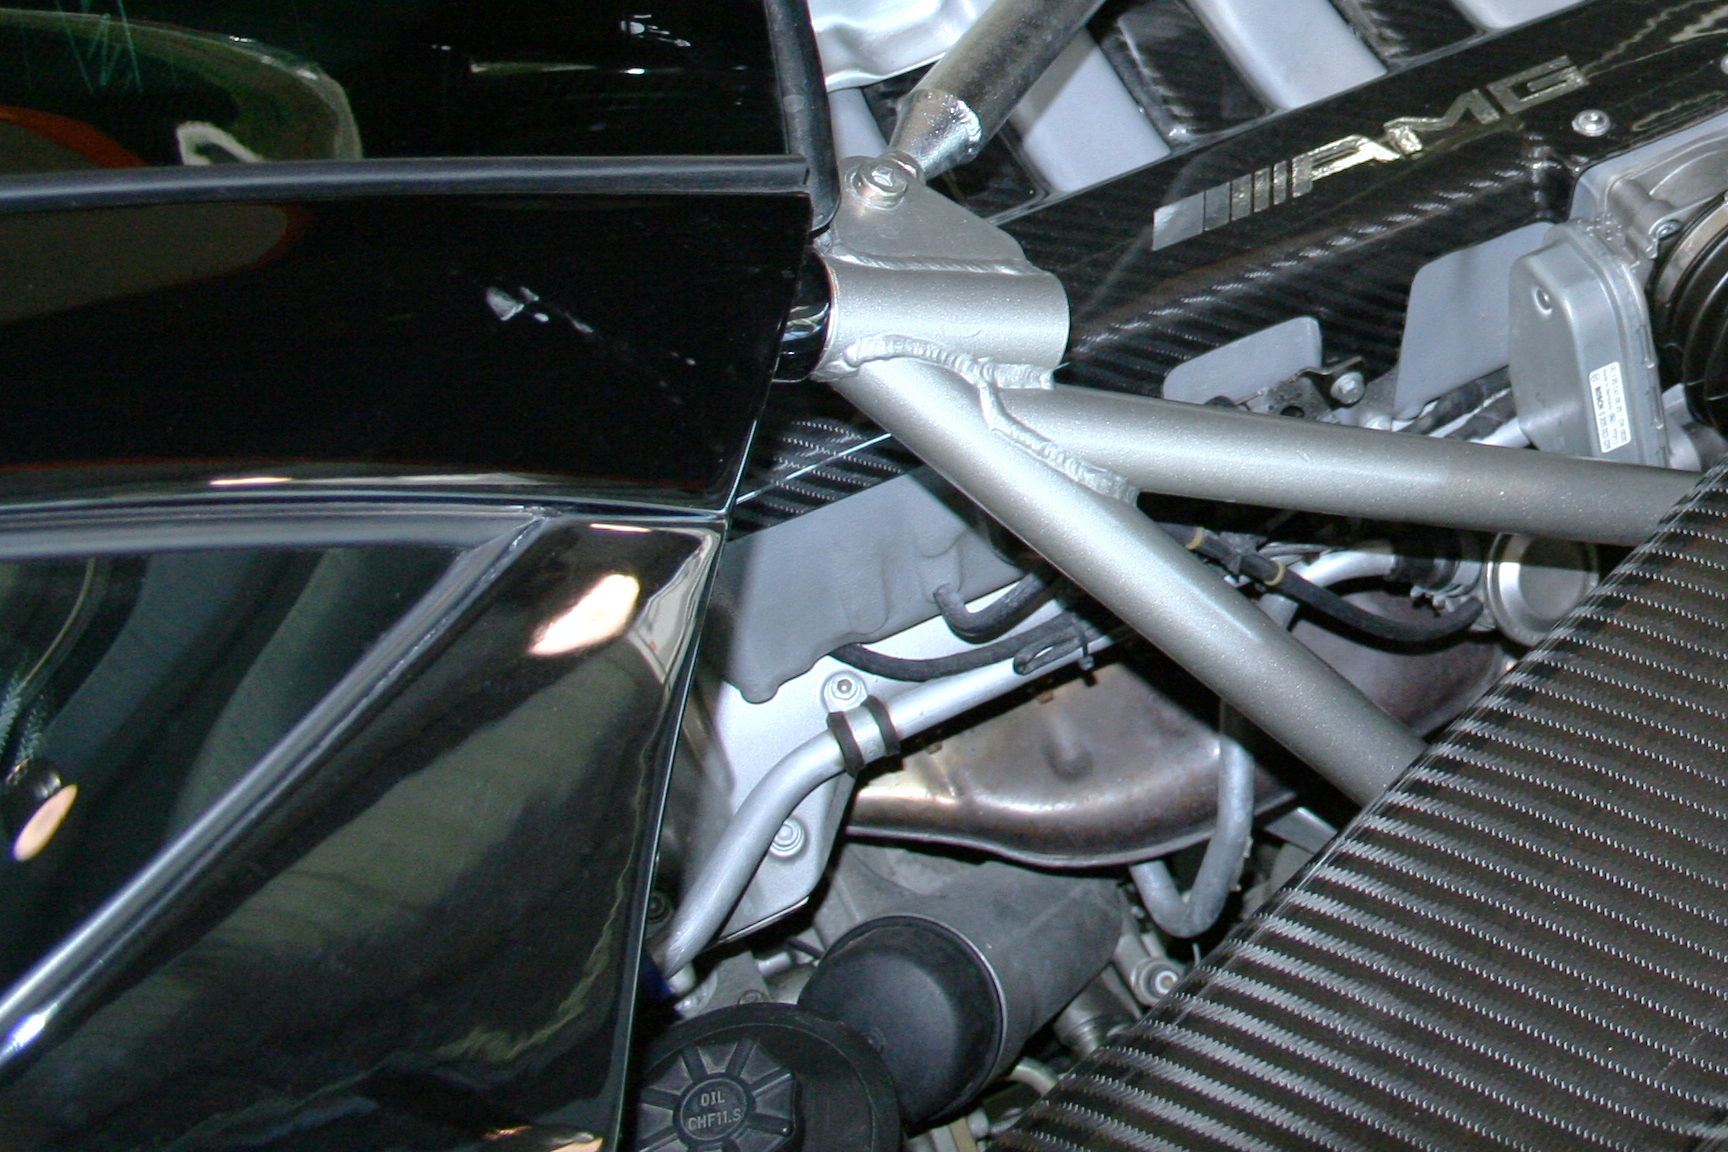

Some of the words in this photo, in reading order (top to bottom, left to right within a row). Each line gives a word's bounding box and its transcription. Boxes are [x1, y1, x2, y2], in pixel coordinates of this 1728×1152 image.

[1290, 54, 1589, 199] AMG
[701, 1091, 726, 1107] OIL
[688, 1108, 741, 1131] CHF11.S
